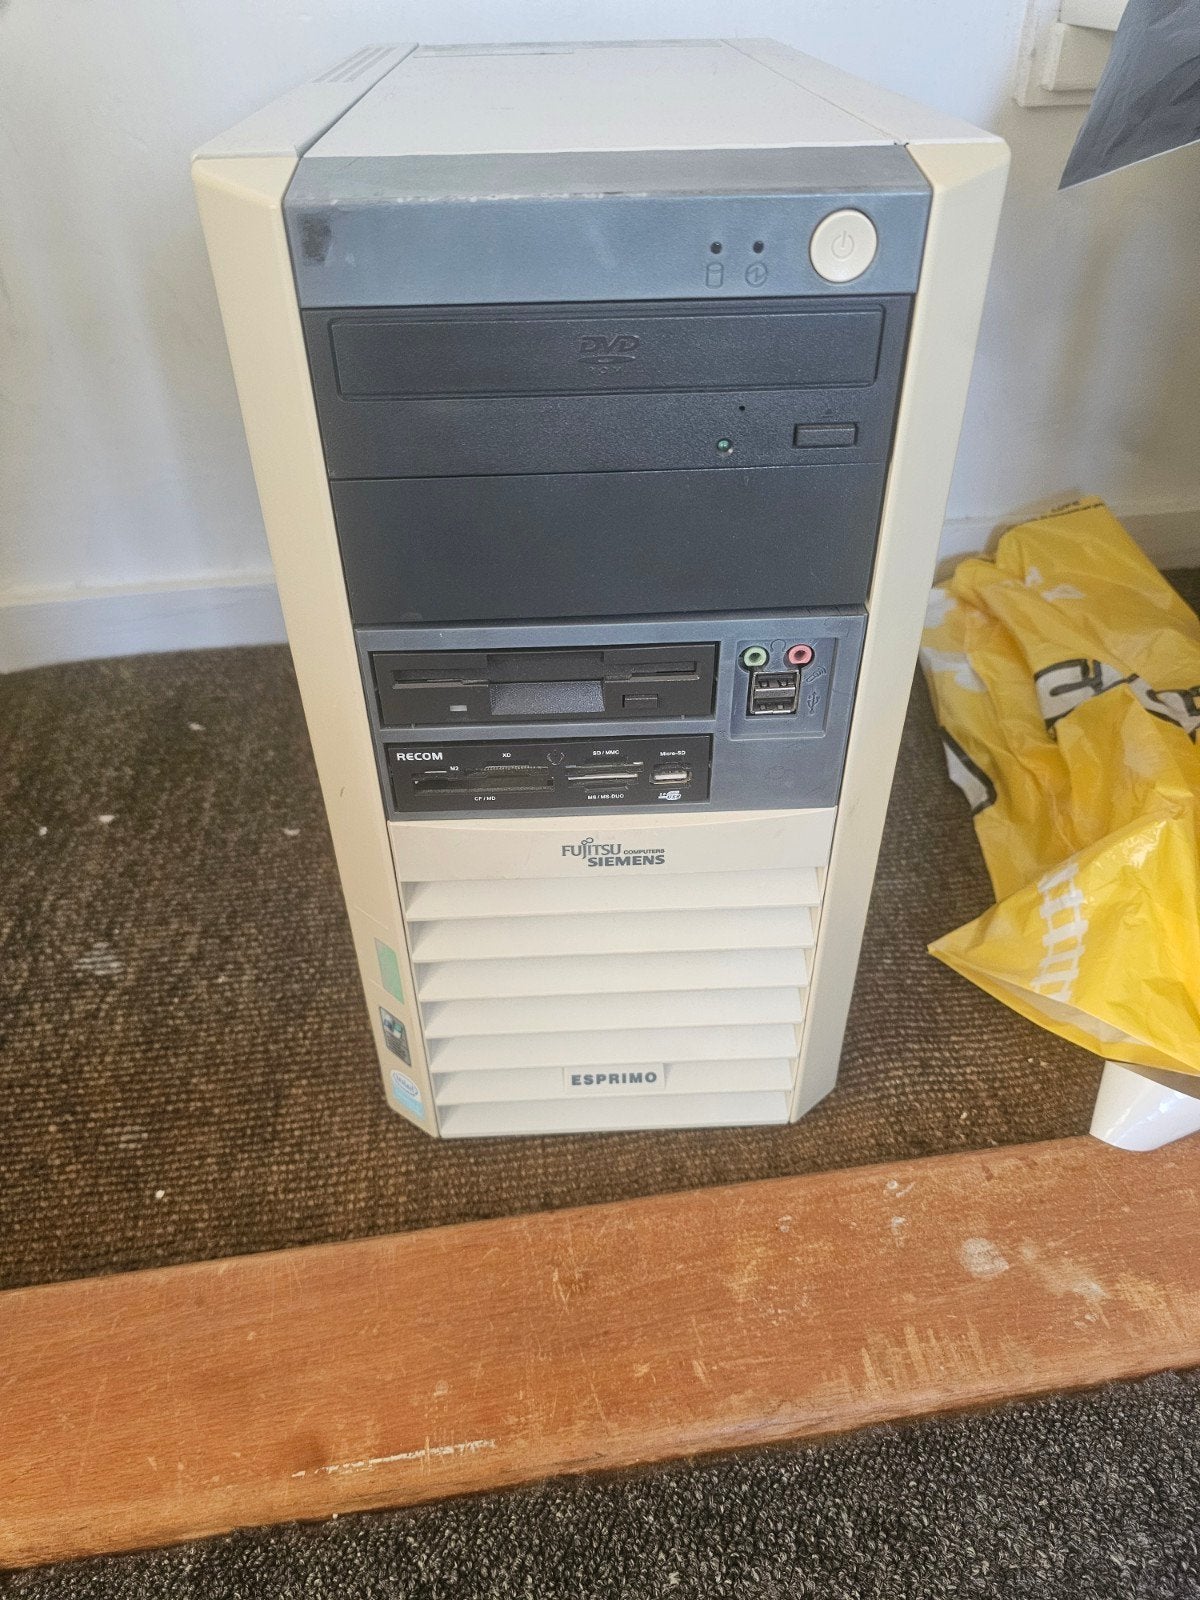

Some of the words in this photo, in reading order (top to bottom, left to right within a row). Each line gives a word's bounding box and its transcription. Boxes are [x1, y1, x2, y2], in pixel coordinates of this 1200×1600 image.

[579, 334, 641, 353] DVD
[396, 752, 443, 761] RECOM
[561, 837, 622, 859] FUJITSU
[587, 854, 665, 867] SIEMENS
[571, 1071, 657, 1086] ESPRIMO
